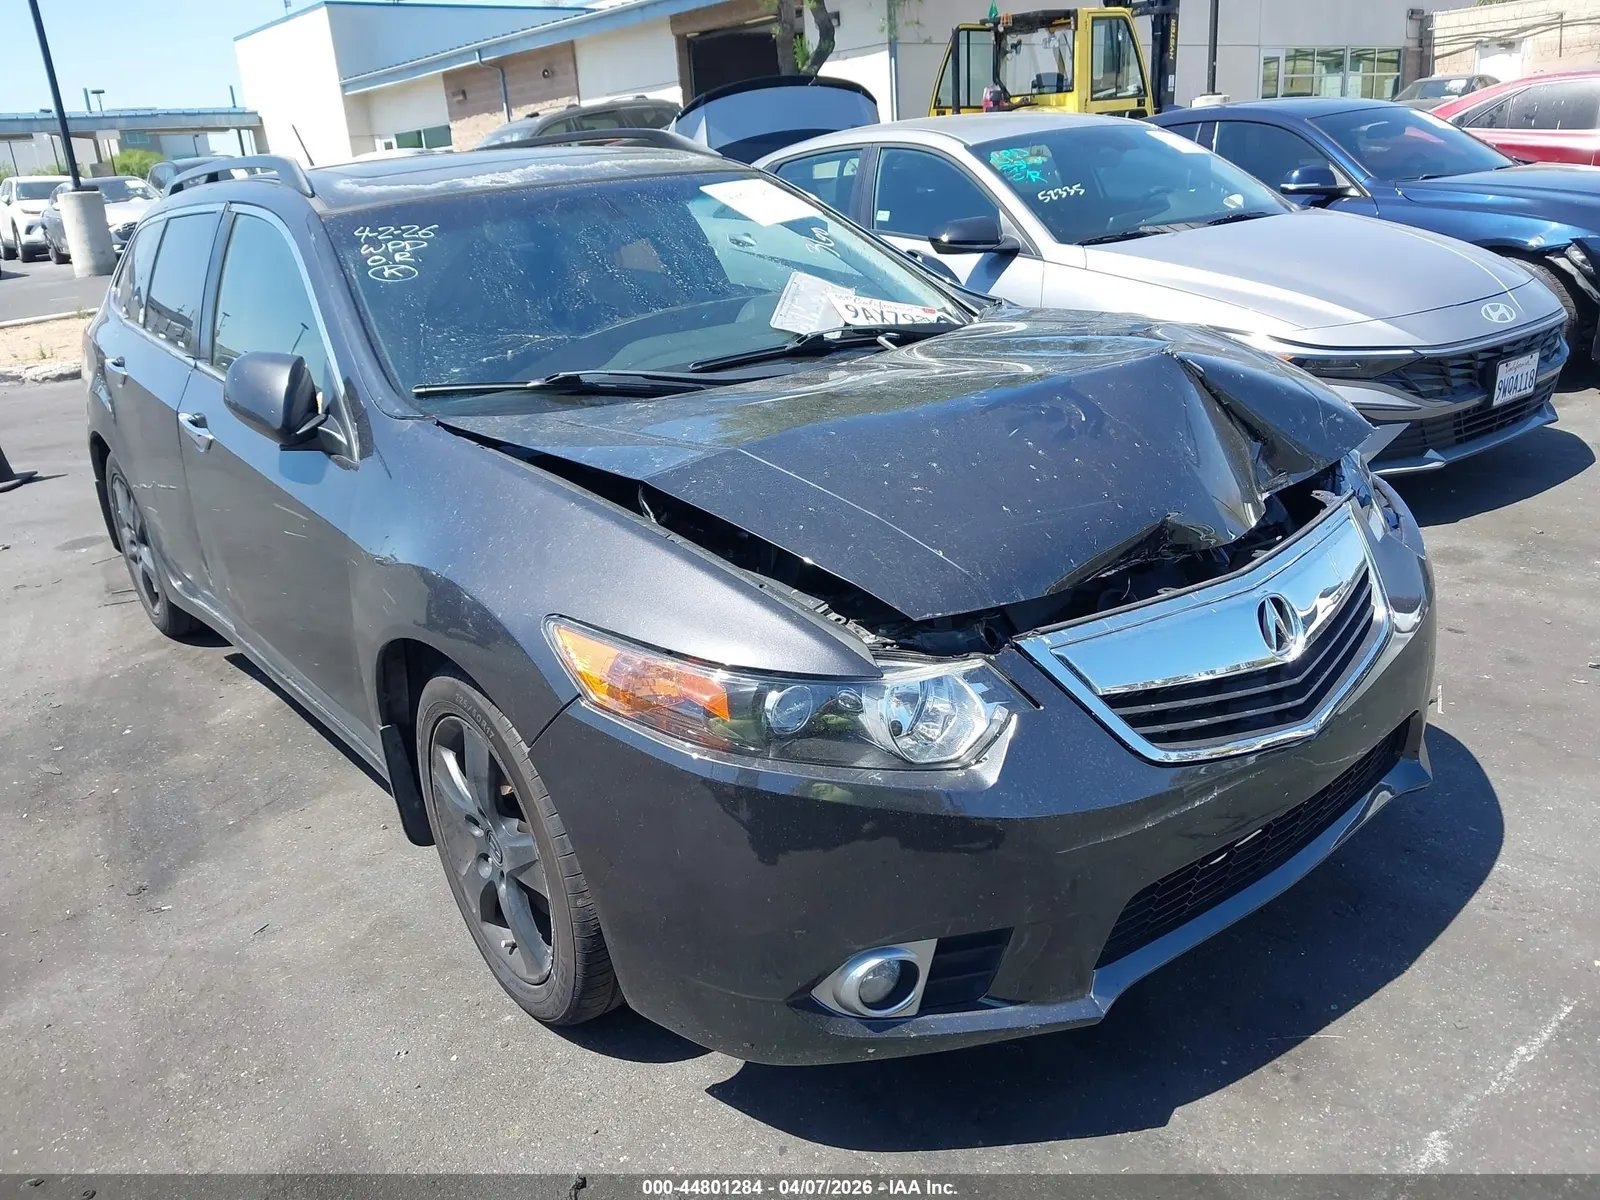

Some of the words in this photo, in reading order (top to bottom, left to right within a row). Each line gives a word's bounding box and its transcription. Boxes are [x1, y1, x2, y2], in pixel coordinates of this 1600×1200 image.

[353, 224, 439, 244] 4-2-26
[360, 240, 428, 255] WPD
[454, 692, 495, 739] 225/50R17
